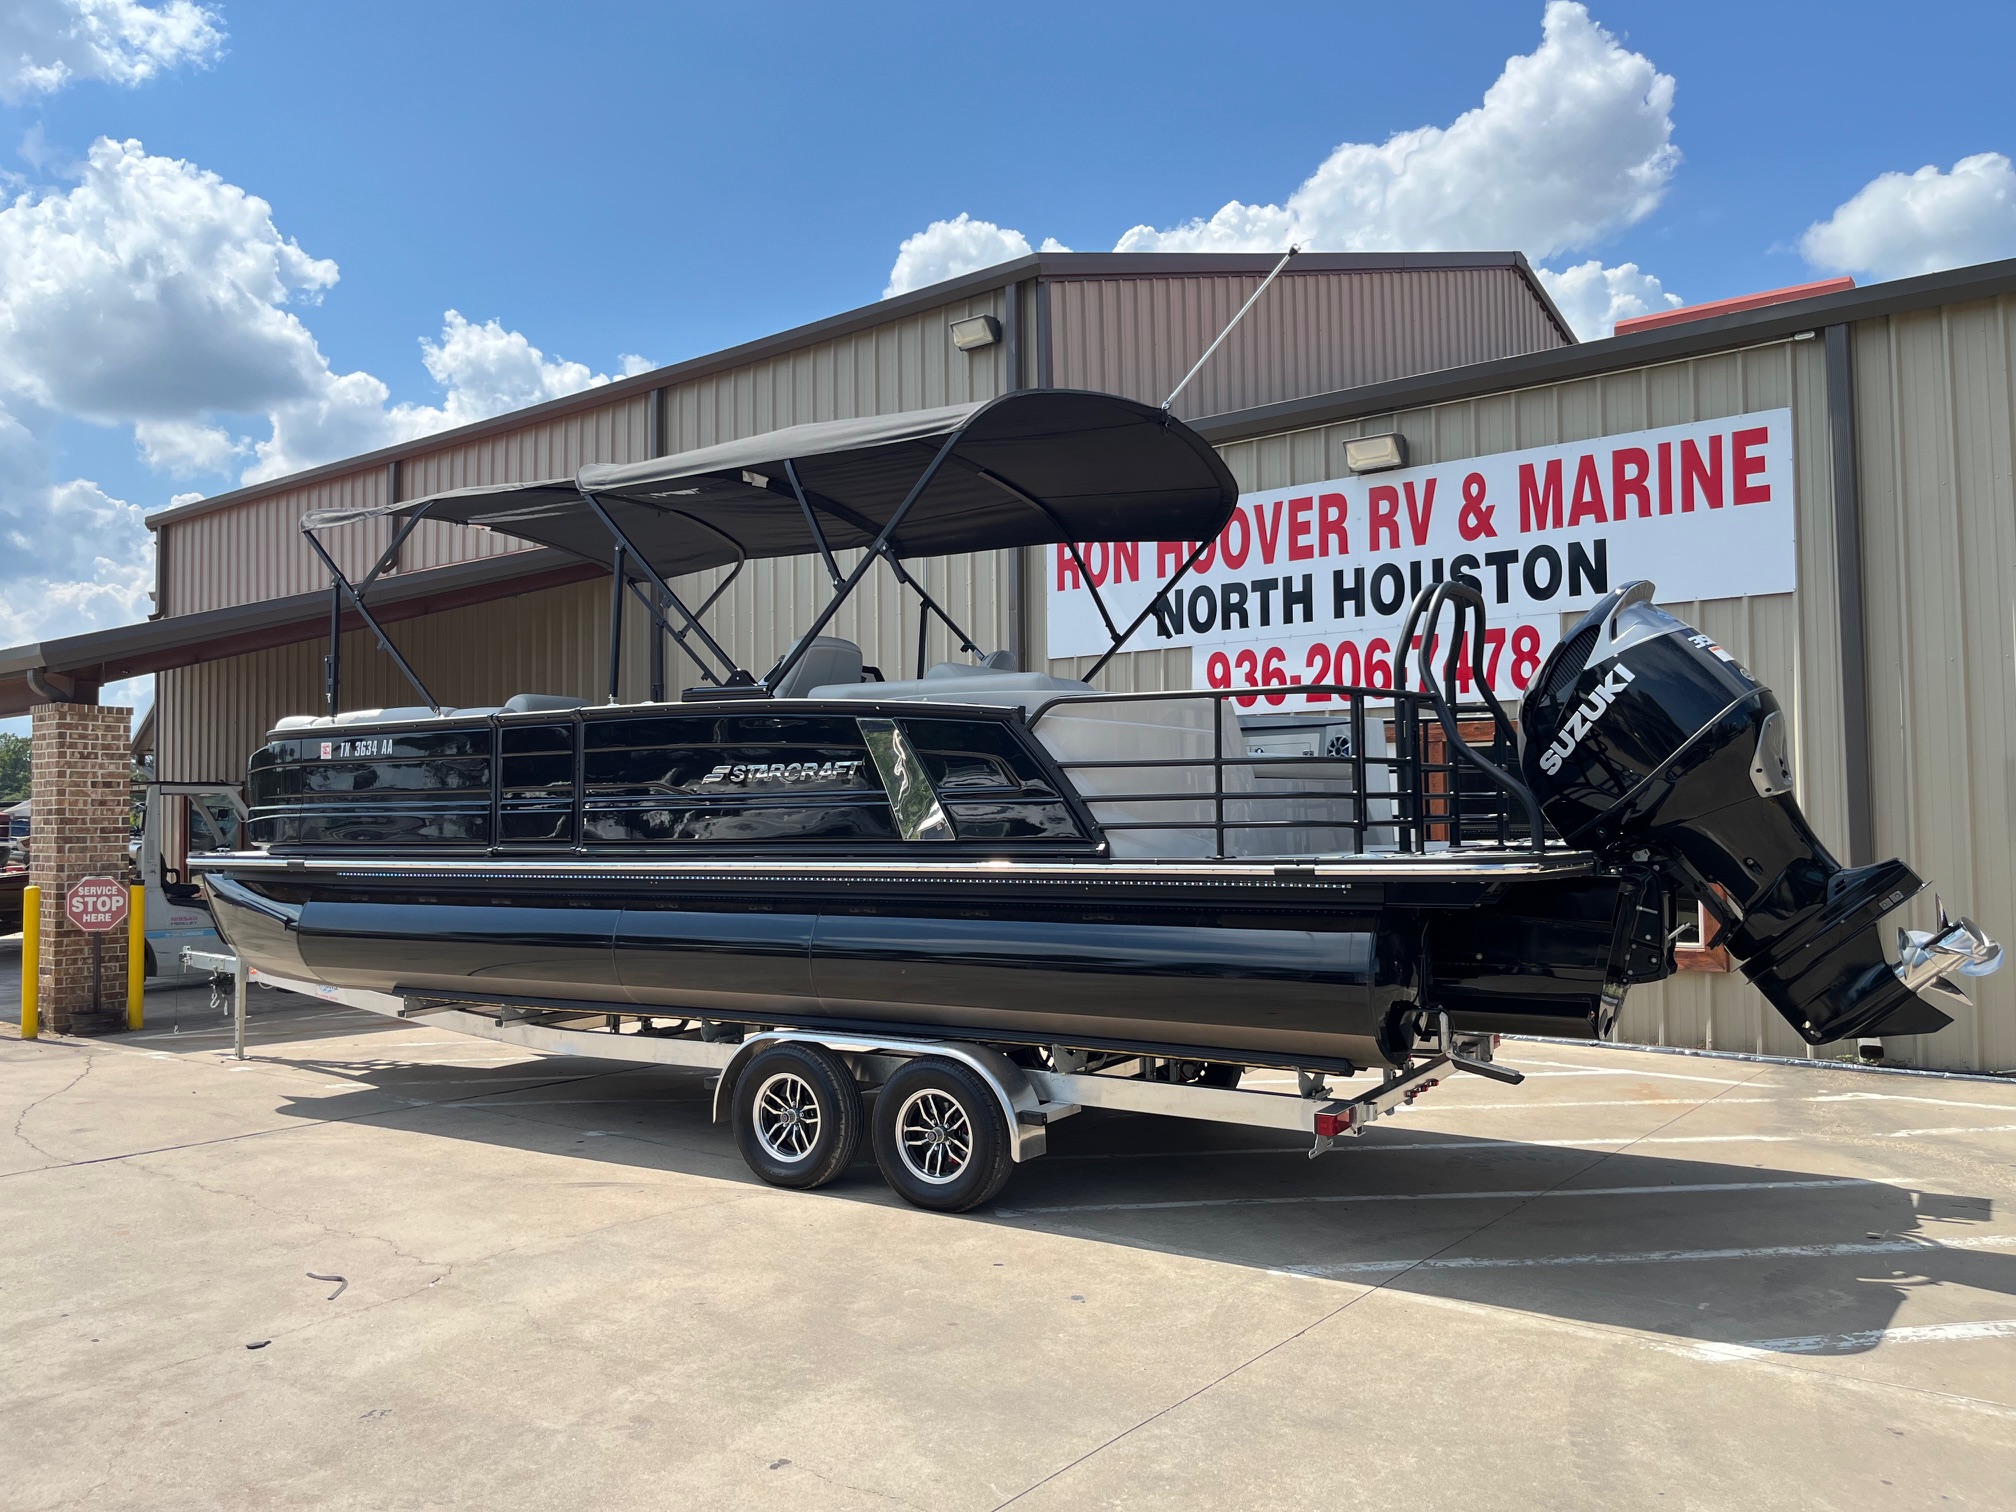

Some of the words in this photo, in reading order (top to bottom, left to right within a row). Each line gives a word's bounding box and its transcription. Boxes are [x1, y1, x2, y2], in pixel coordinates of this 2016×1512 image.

[1056, 541, 1140, 592] RON
[1368, 477, 1438, 552] RV
[1457, 471, 1499, 542] &
[1518, 426, 1771, 534] MARINE
[1156, 572, 1314, 637] NORTH
[1332, 538, 1608, 620] HOUSTON
[1206, 624, 1541, 708] 936-2067478
[1539, 662, 1636, 776] SUZUKI
[340, 742, 351, 758] TX
[354, 740, 378, 757] 3634
[381, 738, 393, 755] AA
[729, 760, 863, 783] STARCRAFT
[78, 886, 118, 895] SERVICE
[71, 896, 124, 912] STOP
[82, 913, 112, 922] HERE
